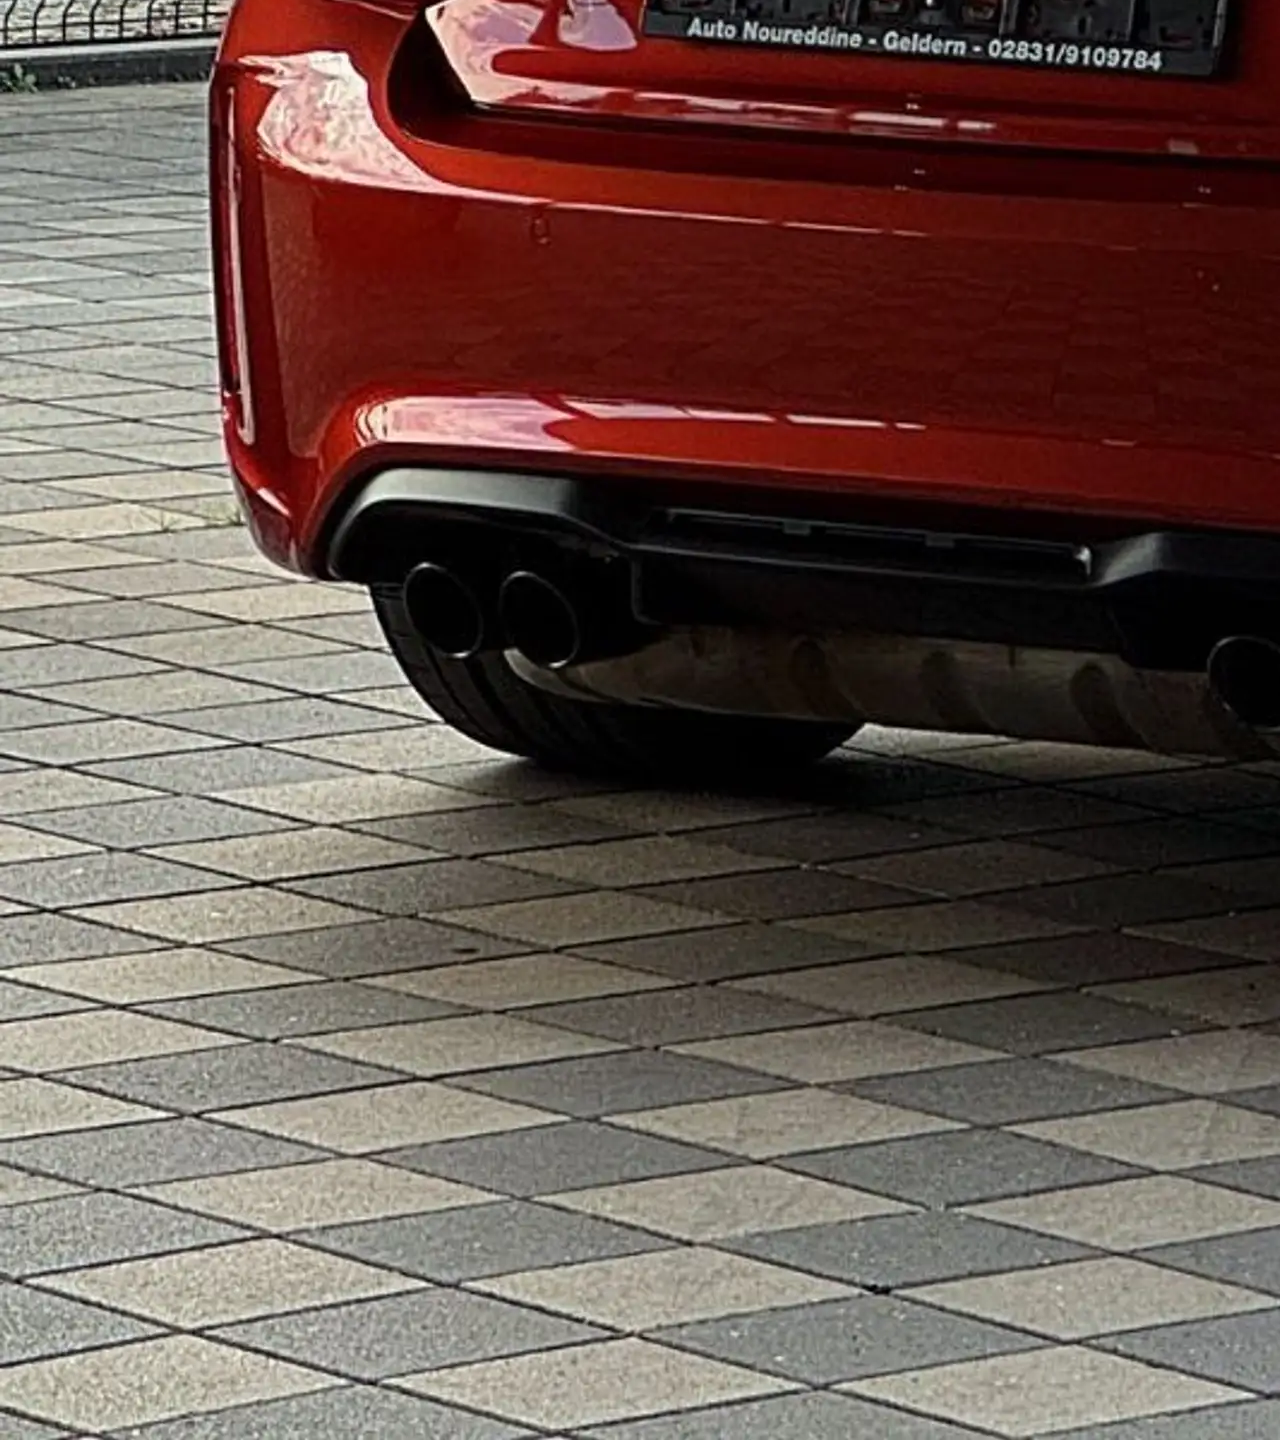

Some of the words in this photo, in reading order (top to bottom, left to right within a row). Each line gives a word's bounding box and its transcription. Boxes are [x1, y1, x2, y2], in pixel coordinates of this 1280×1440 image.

[687, 17, 736, 40] Auto
[743, 21, 862, 48] Noureddine
[883, 31, 966, 56] Geldern
[988, 39, 1163, 71] 02831/9109784
